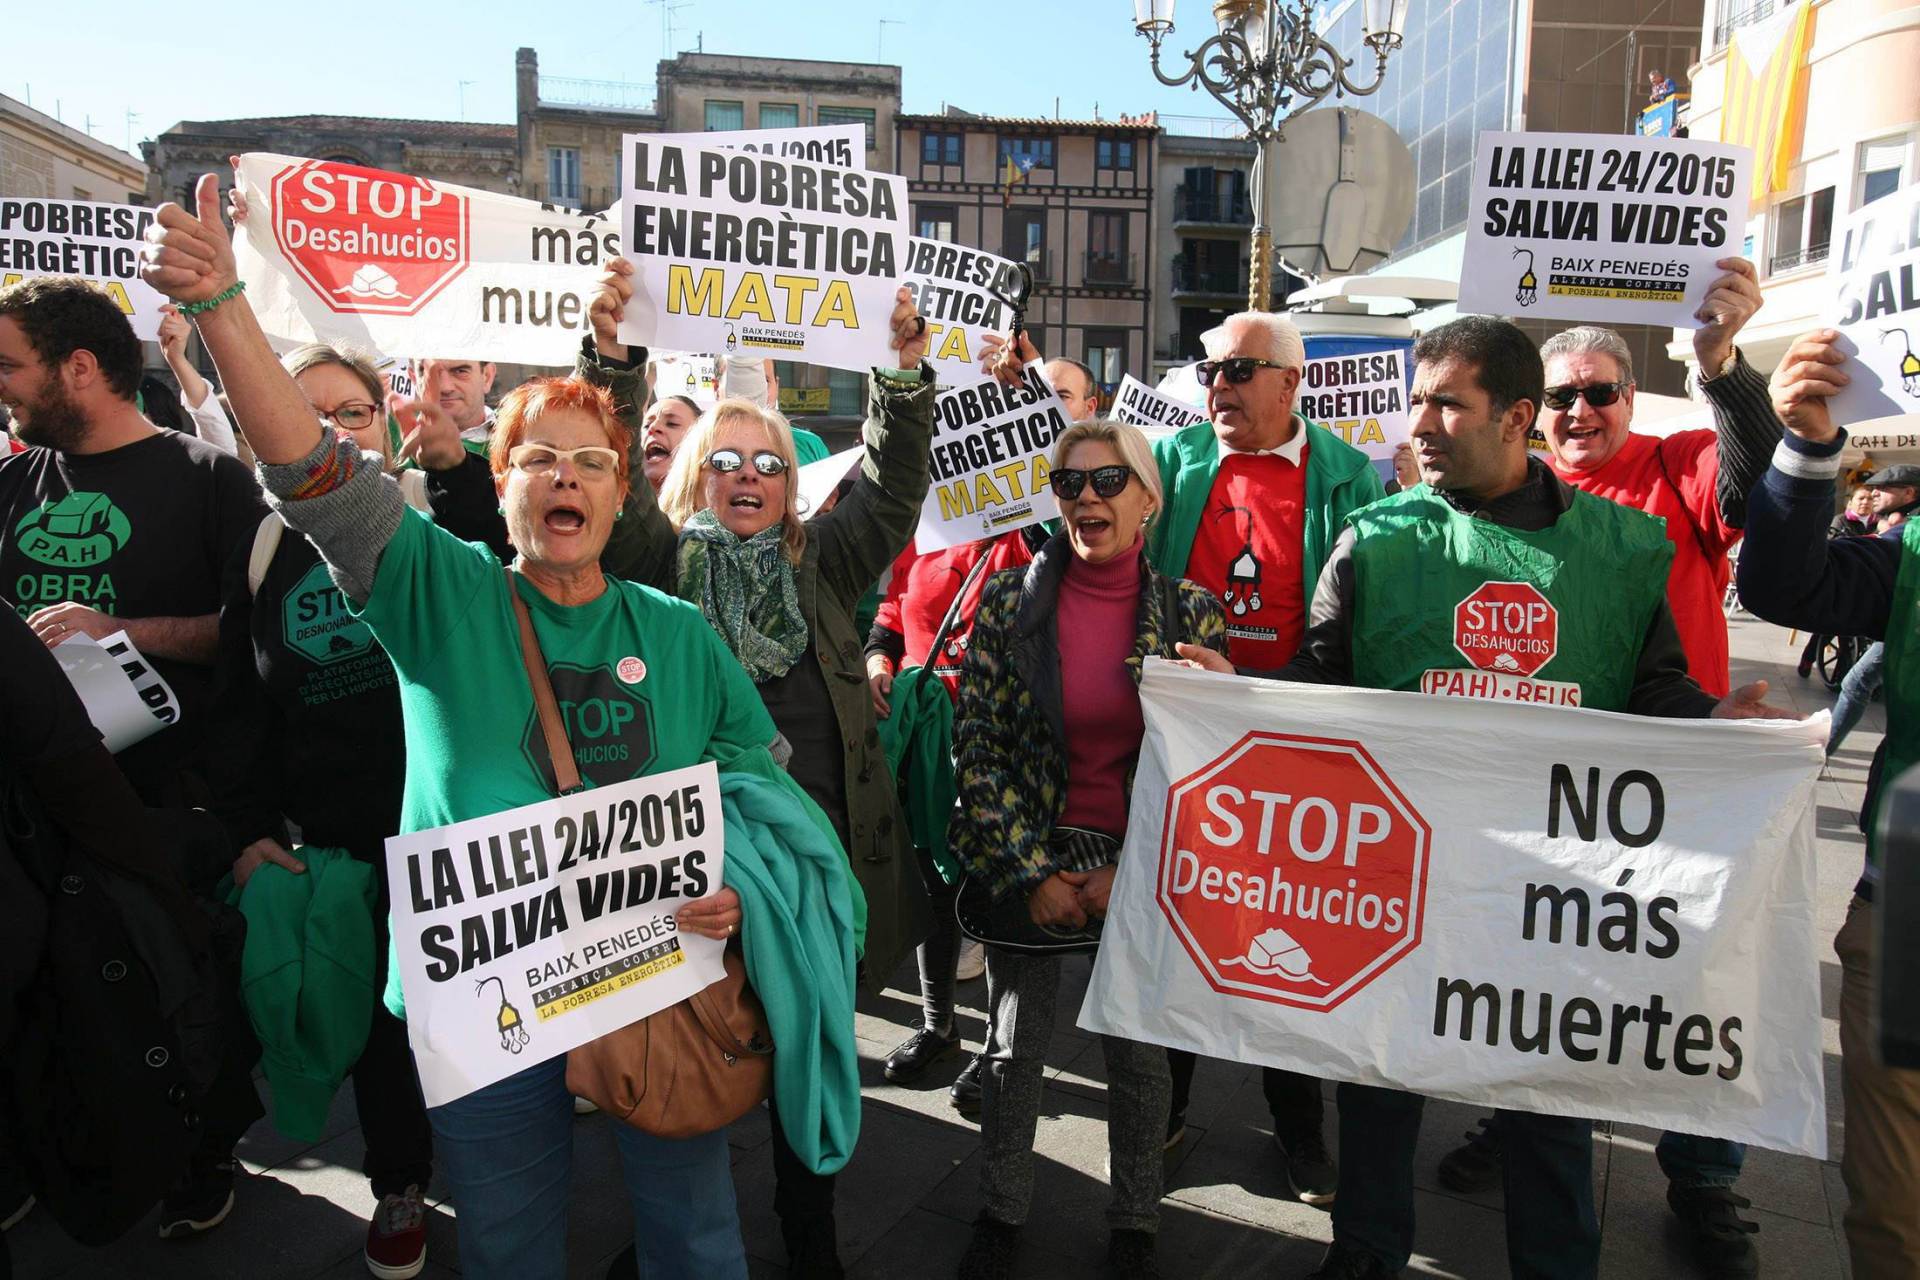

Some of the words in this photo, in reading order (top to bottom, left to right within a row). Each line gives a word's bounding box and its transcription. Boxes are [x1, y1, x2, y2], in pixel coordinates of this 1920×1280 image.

[743, 138, 852, 168] /2015
[1488, 146, 1525, 188] LA
[1531, 147, 1595, 191] LLEI
[1597, 149, 1736, 199] 24/2015
[301, 169, 443, 221] STOP
[634, 142, 688, 195] LA
[700, 151, 898, 222] POBRESA
[286, 220, 457, 262] Desahucios
[532, 219, 620, 266] más
[633, 205, 897, 278] ENERGÈTICA
[1484, 198, 1598, 242] SALVA
[1611, 203, 1728, 248] VIDES
[0, 236, 143, 280] ERGÈTIC
[1551, 257, 1595, 273] BAIX
[1600, 260, 1690, 278] PENEDÉS
[1552, 276, 1615, 289] ALIANÇA
[1626, 280, 1681, 290] CONTRA
[667, 264, 860, 329] MATA
[1551, 286, 1563, 294] LA
[1568, 288, 1611, 298] POBRESA
[1616, 290, 1678, 301] ENERGÈTICA
[742, 327, 763, 335] BAIX
[389, 373, 412, 396] ICA
[1122, 384, 1139, 408] LA
[1137, 392, 1168, 423] LLEI
[936, 453, 1051, 521] MATA
[16, 574, 117, 600] OBRA
[296, 615, 359, 641] DESNONAM
[1465, 600, 1549, 634] STOP
[1462, 633, 1549, 655] DESAHUCIOS
[1199, 783, 1393, 868] STOP
[1546, 763, 1667, 849] NO
[406, 848, 465, 914] LA
[467, 824, 549, 899] LLEI
[554, 784, 706, 873] 24/2015
[420, 886, 569, 983] SALVA
[576, 849, 709, 923] VIDES
[1172, 849, 1405, 937] Desahucios
[1521, 868, 1681, 960] más
[526, 952, 580, 988] BAIX
[583, 914, 677, 965] PENEDÉS
[536, 966, 613, 1005] ALIANÇA
[623, 941, 679, 969] CONTRA
[541, 1006, 558, 1020] LA
[562, 982, 615, 1011] POBRESA
[620, 953, 683, 987] ENERGÈTICA
[1433, 975, 1744, 1083] muertes
